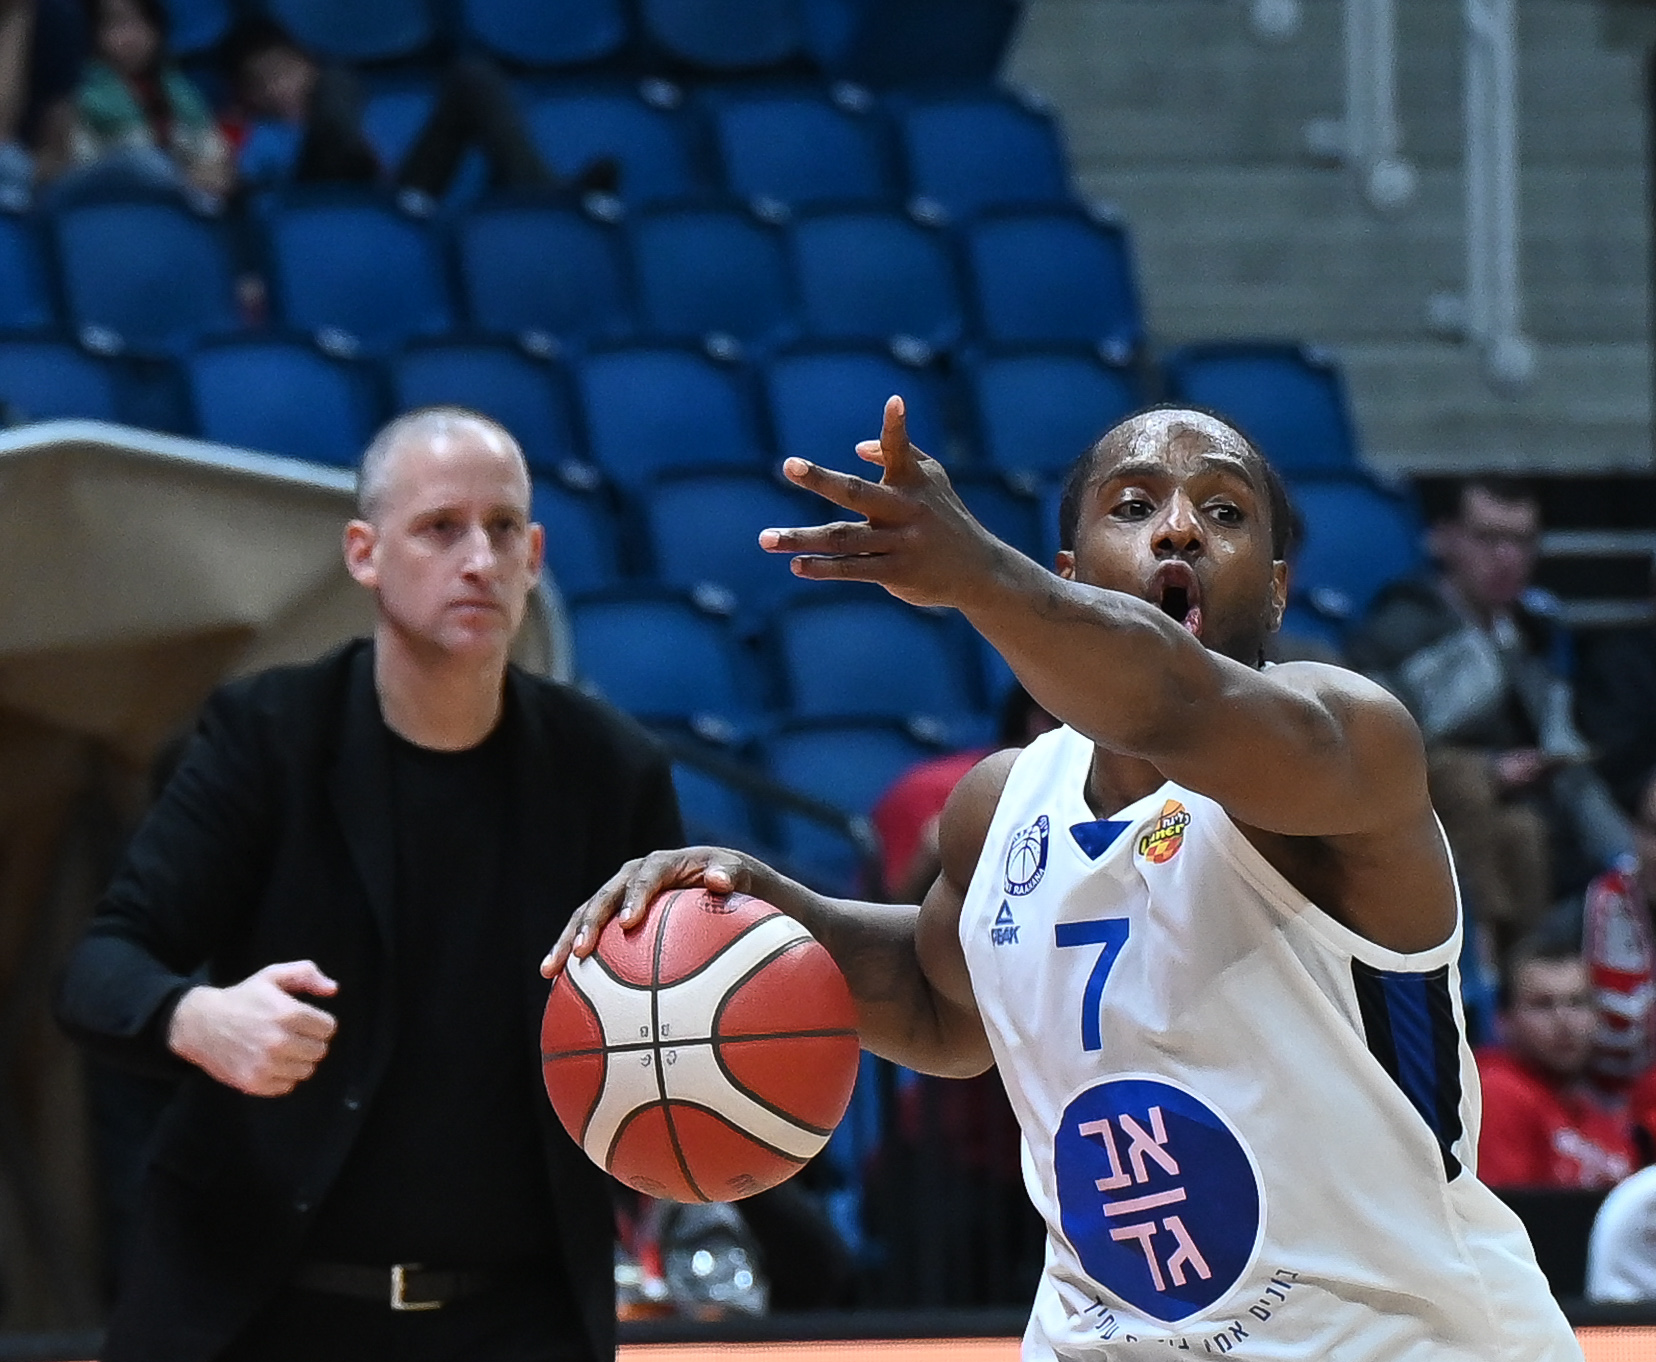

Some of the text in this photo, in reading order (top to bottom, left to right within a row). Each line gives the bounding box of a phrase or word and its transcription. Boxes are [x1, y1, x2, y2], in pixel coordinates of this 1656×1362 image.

[991, 925, 1021, 947] PEAK
[1053, 916, 1131, 1052] 7
[1079, 1105, 1180, 1191] אב
[1108, 1214, 1212, 1292] גד
[1248, 1268, 1299, 1322] בונים
